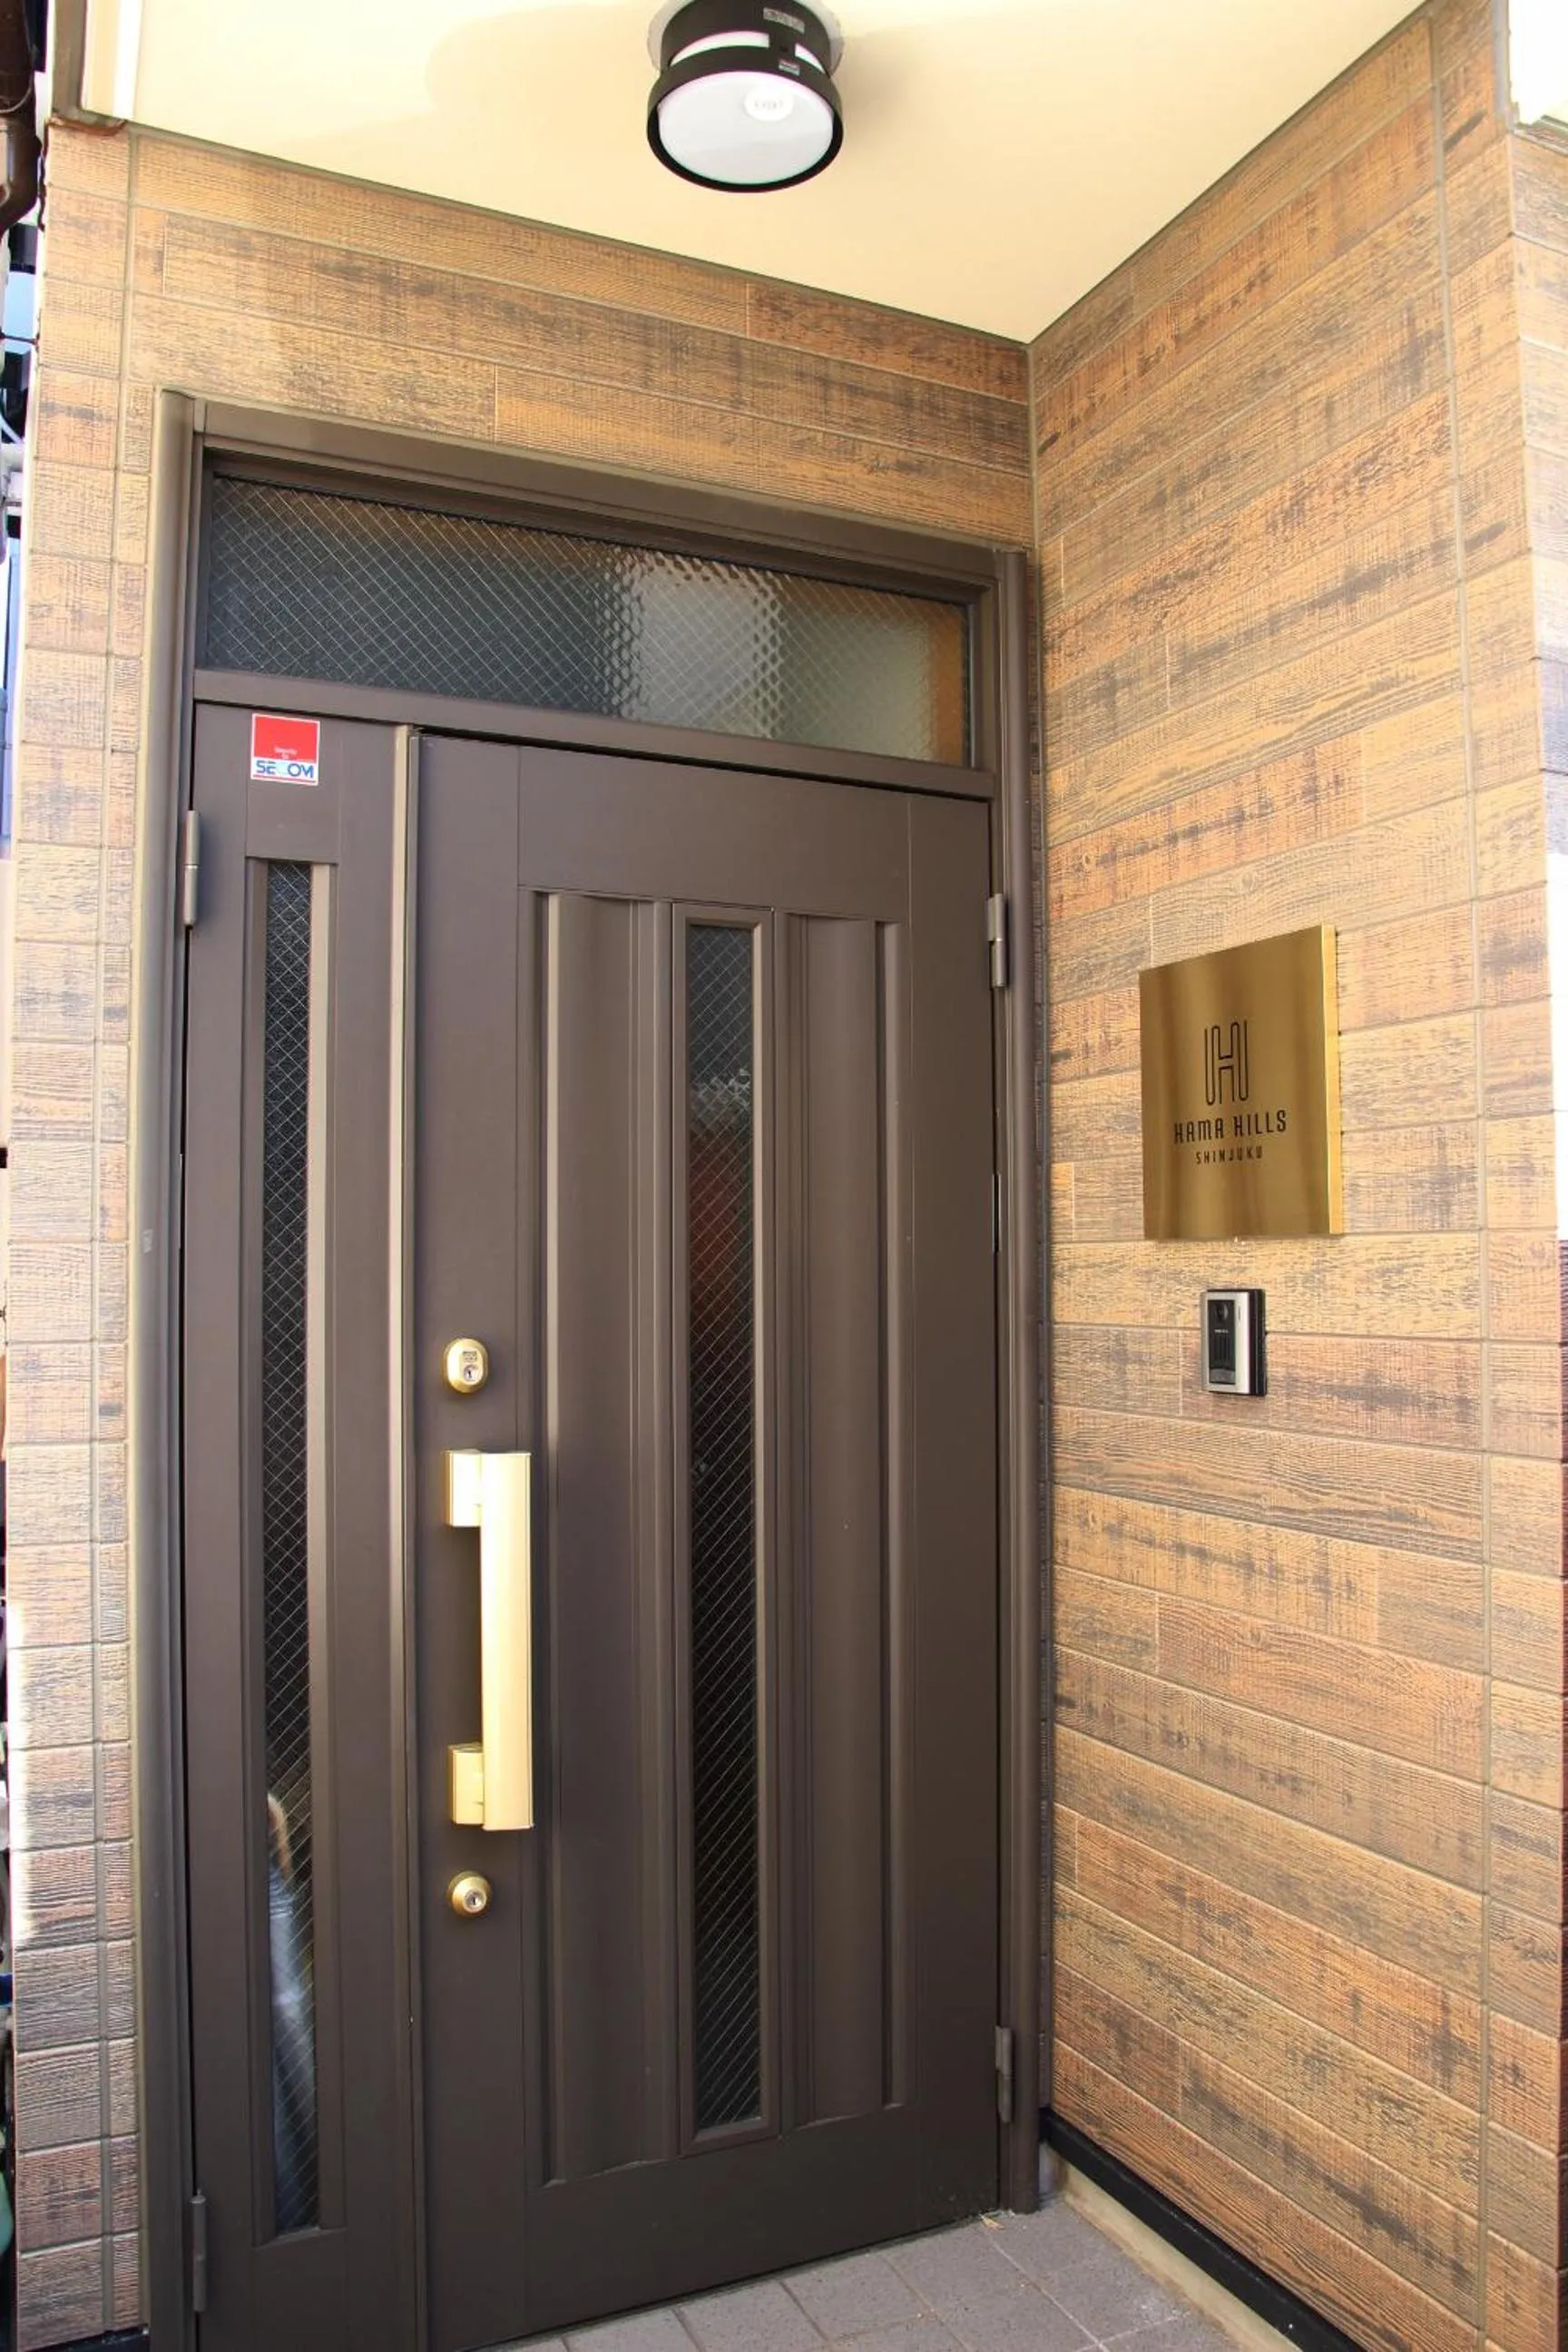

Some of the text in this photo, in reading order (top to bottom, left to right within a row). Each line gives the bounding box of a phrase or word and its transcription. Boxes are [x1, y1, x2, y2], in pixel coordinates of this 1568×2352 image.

[255, 760, 315, 779] SEOM
[1173, 1109, 1287, 1144] HAMA HILLS
[1195, 1145, 1263, 1165] SHINJUKU
